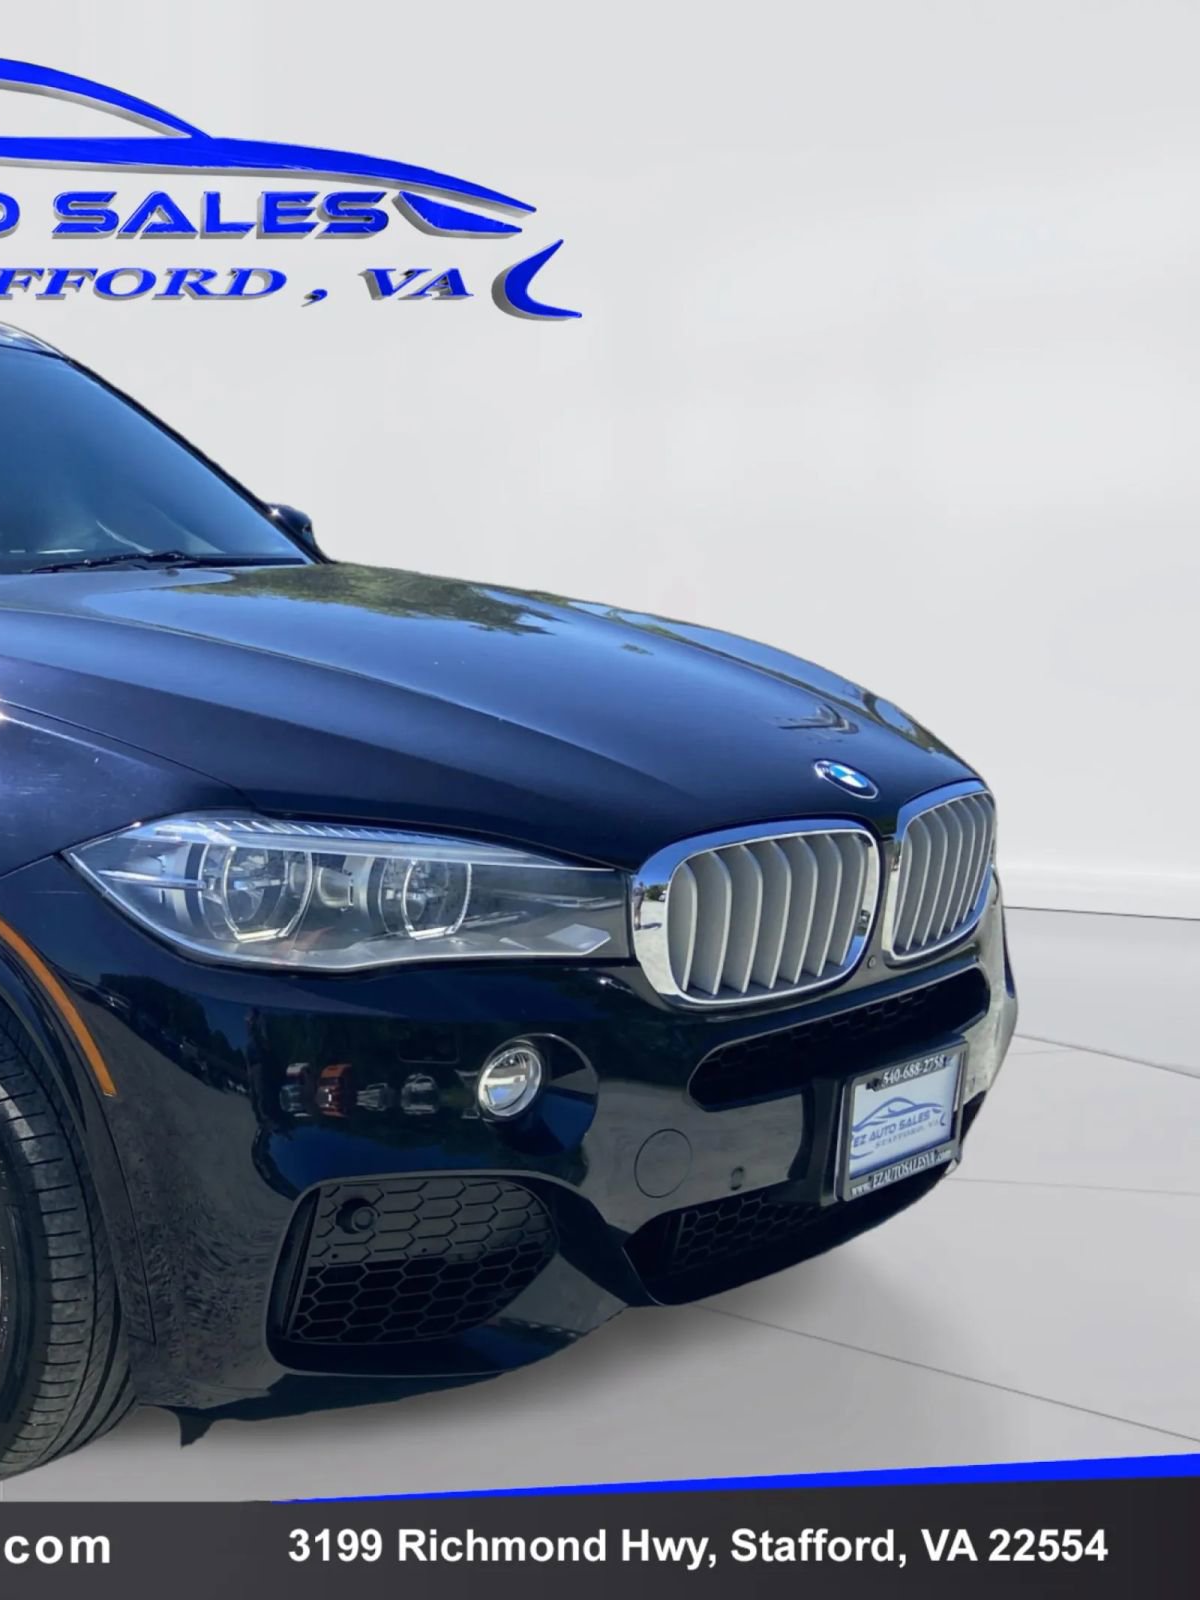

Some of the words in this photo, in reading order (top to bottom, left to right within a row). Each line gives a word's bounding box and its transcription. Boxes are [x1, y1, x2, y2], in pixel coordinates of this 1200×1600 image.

[50, 190, 389, 237] SALES
[359, 267, 475, 300] VA
[881, 1054, 946, 1087] 540-688-2758
[869, 1123, 897, 1142] AUTO
[899, 1110, 931, 1130] SALES
